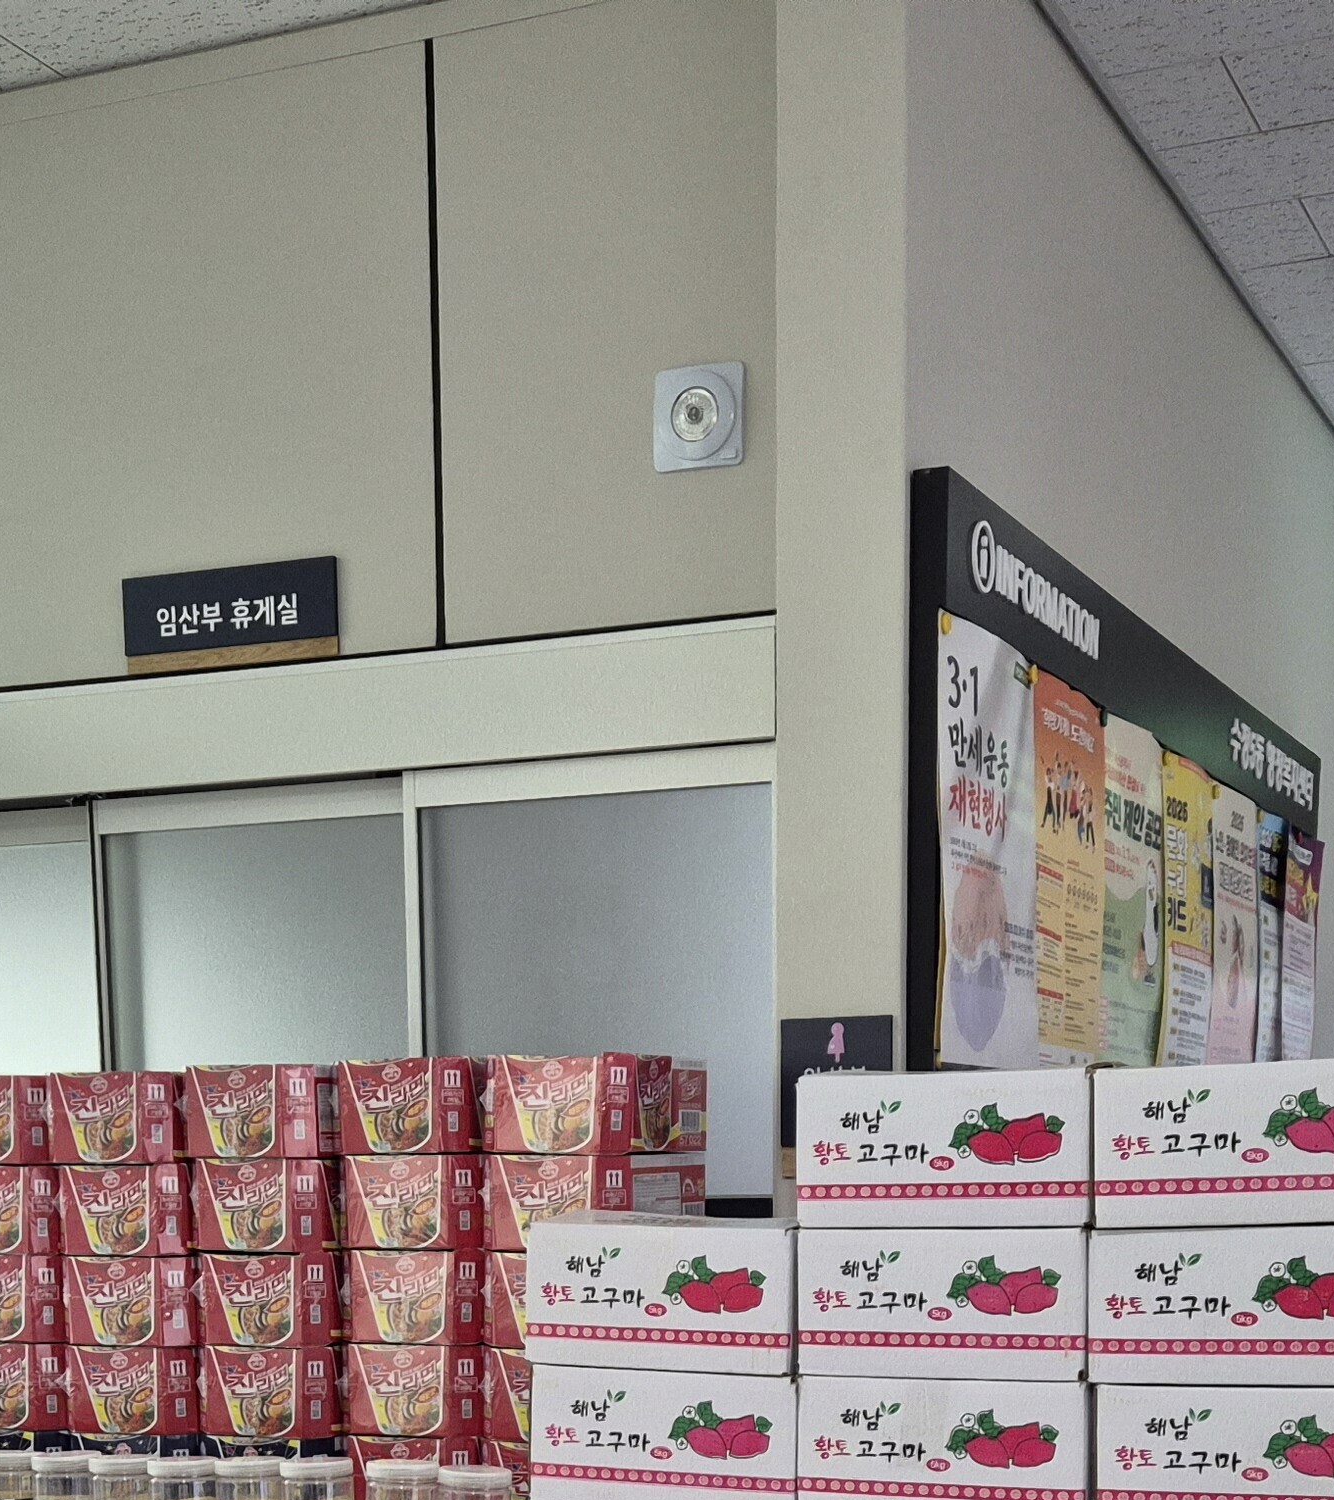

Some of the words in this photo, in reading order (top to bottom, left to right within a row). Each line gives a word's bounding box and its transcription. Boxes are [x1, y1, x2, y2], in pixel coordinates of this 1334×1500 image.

[156, 601, 223, 637] 임산부
[229, 593, 298, 630] 휴게실
[995, 544, 1100, 660] INFORMATION
[948, 717, 1010, 788] 만세운동
[948, 777, 1009, 843] 재현행사
[206, 1081, 270, 1117] 진라면
[360, 1073, 429, 1114] 진라면
[516, 1071, 588, 1114] 진라면
[841, 1109, 883, 1134] 해남
[1143, 1097, 1190, 1123] 해남
[813, 1142, 851, 1166] 황토
[857, 1142, 929, 1165] 고구마
[1112, 1132, 1154, 1158] 황토
[1164, 1132, 1241, 1156] 고구마
[567, 1255, 605, 1278] 해남
[1135, 1260, 1182, 1287] 해남
[542, 1283, 575, 1306] 황토
[582, 1287, 645, 1308] 고구마
[1106, 1294, 1147, 1319] 황토
[1153, 1294, 1230, 1319] 고구마
[841, 1408, 883, 1432] 해남
[814, 1436, 851, 1459] 황토
[857, 1441, 926, 1462] 고구마
